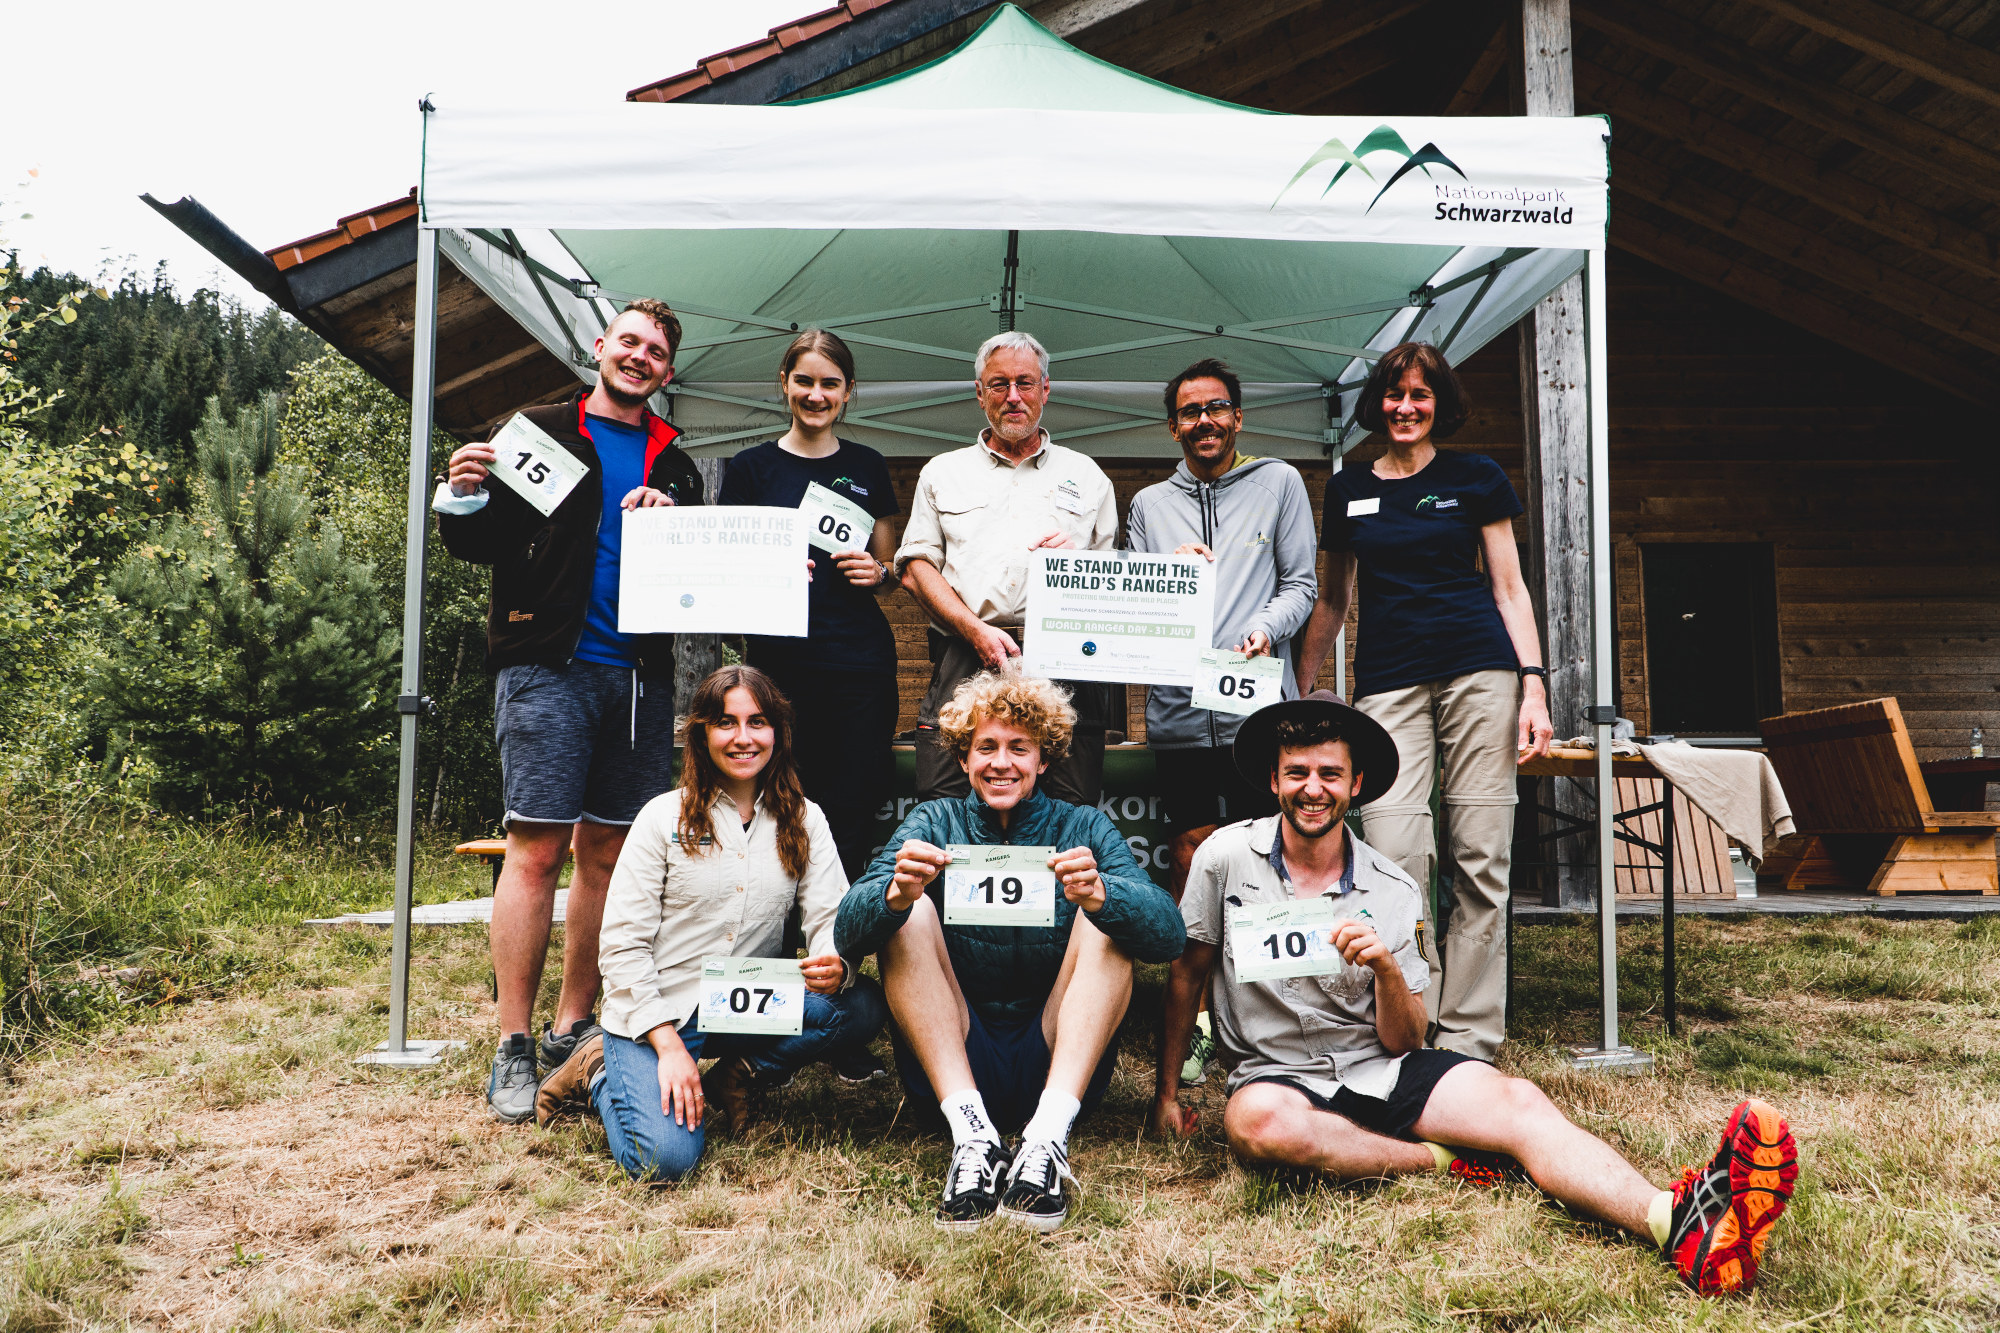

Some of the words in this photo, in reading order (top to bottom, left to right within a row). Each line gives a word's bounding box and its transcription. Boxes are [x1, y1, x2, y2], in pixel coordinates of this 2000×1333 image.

[1435, 184, 1566, 206] Nationalpark
[1435, 202, 1573, 224] Schwarzwald
[514, 451, 552, 485] 15
[640, 517, 663, 529] WE
[668, 516, 717, 530] STAND
[721, 516, 761, 530] WITH
[767, 517, 794, 531] THE
[818, 514, 852, 543] 06
[641, 530, 711, 545] WORLD'S
[718, 531, 793, 547] RANGERS
[1045, 557, 1069, 572] WE
[1073, 559, 1123, 575] STAND
[1127, 561, 1167, 577] WITH
[1171, 563, 1200, 579] THE
[1046, 574, 1116, 591] WORLD'S
[1122, 577, 1198, 595] RANGERS
[1062, 593, 1098, 602] PROTECTING
[1098, 595, 1124, 603] WILDLIFE
[1126, 596, 1139, 604] AND
[1045, 620, 1082, 631] WORLD
[1084, 622, 1125, 634] RANGER
[1127, 626, 1148, 636] DAY
[1155, 628, 1167, 636] 31
[1169, 629, 1192, 638] JULY
[1219, 675, 1256, 700] 05
[985, 853, 1011, 863] RANGERS
[978, 876, 1023, 904] 19
[1266, 910, 1290, 922] RANGERS
[1263, 931, 1307, 960] 10
[738, 966, 763, 975] RANGERS
[729, 987, 774, 1014] 07
